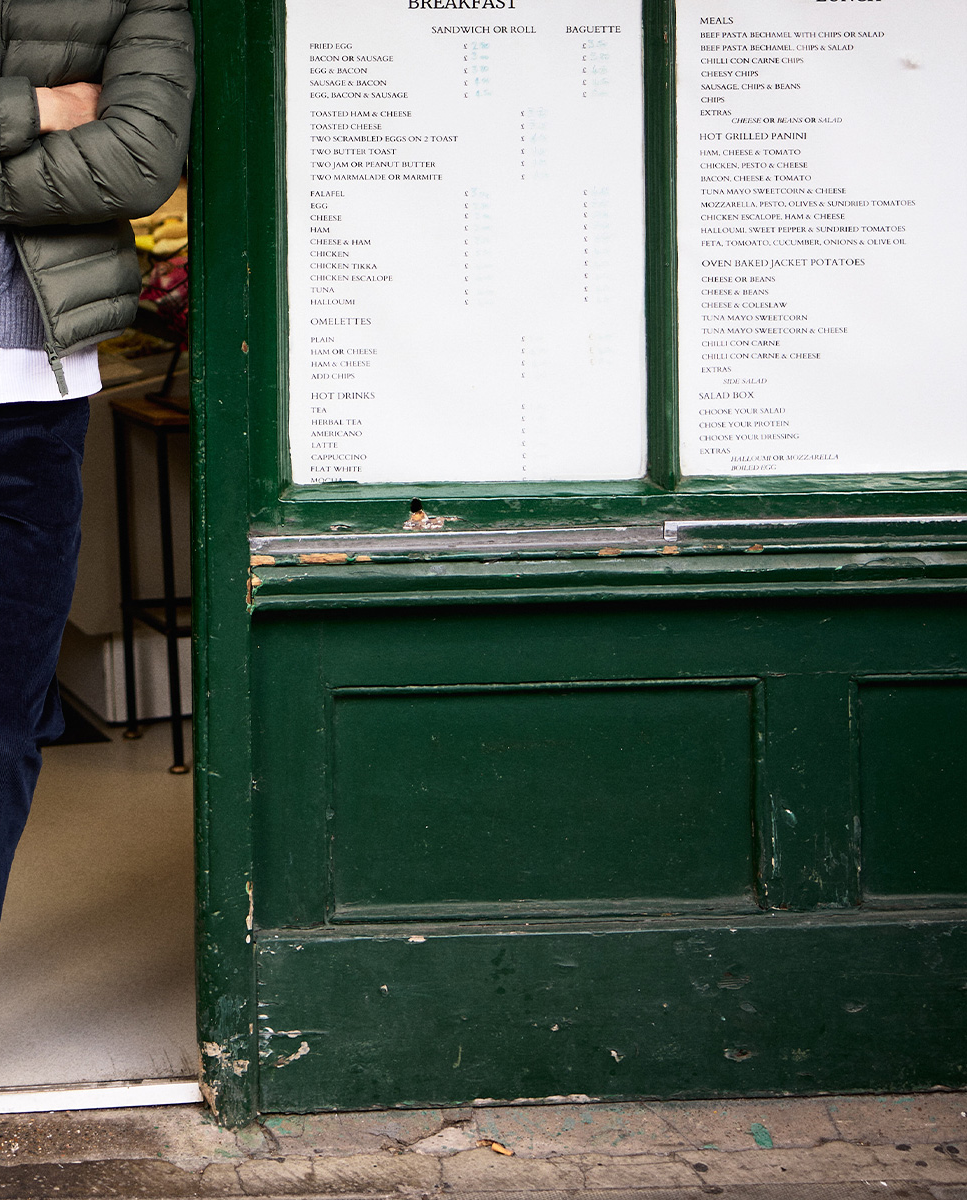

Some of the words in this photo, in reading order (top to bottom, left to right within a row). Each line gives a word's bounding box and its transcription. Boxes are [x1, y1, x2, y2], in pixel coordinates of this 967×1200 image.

[700, 16, 734, 25] MEALS
[431, 26, 490, 34] SANDWICH
[493, 25, 508, 34] OR
[510, 25, 536, 34] ROLL
[566, 25, 621, 34] BAGUETTE
[725, 132, 769, 140] GRILLED
[771, 132, 807, 140] PANINI
[331, 161, 349, 170] JAM
[735, 259, 769, 267] BAKED
[769, 259, 808, 269] JACKET
[810, 258, 865, 266] POTATOES
[311, 392, 335, 400] HOT
[337, 392, 375, 400] DRINKS
[699, 392, 730, 400] SALAD
[733, 391, 754, 399] BOX
